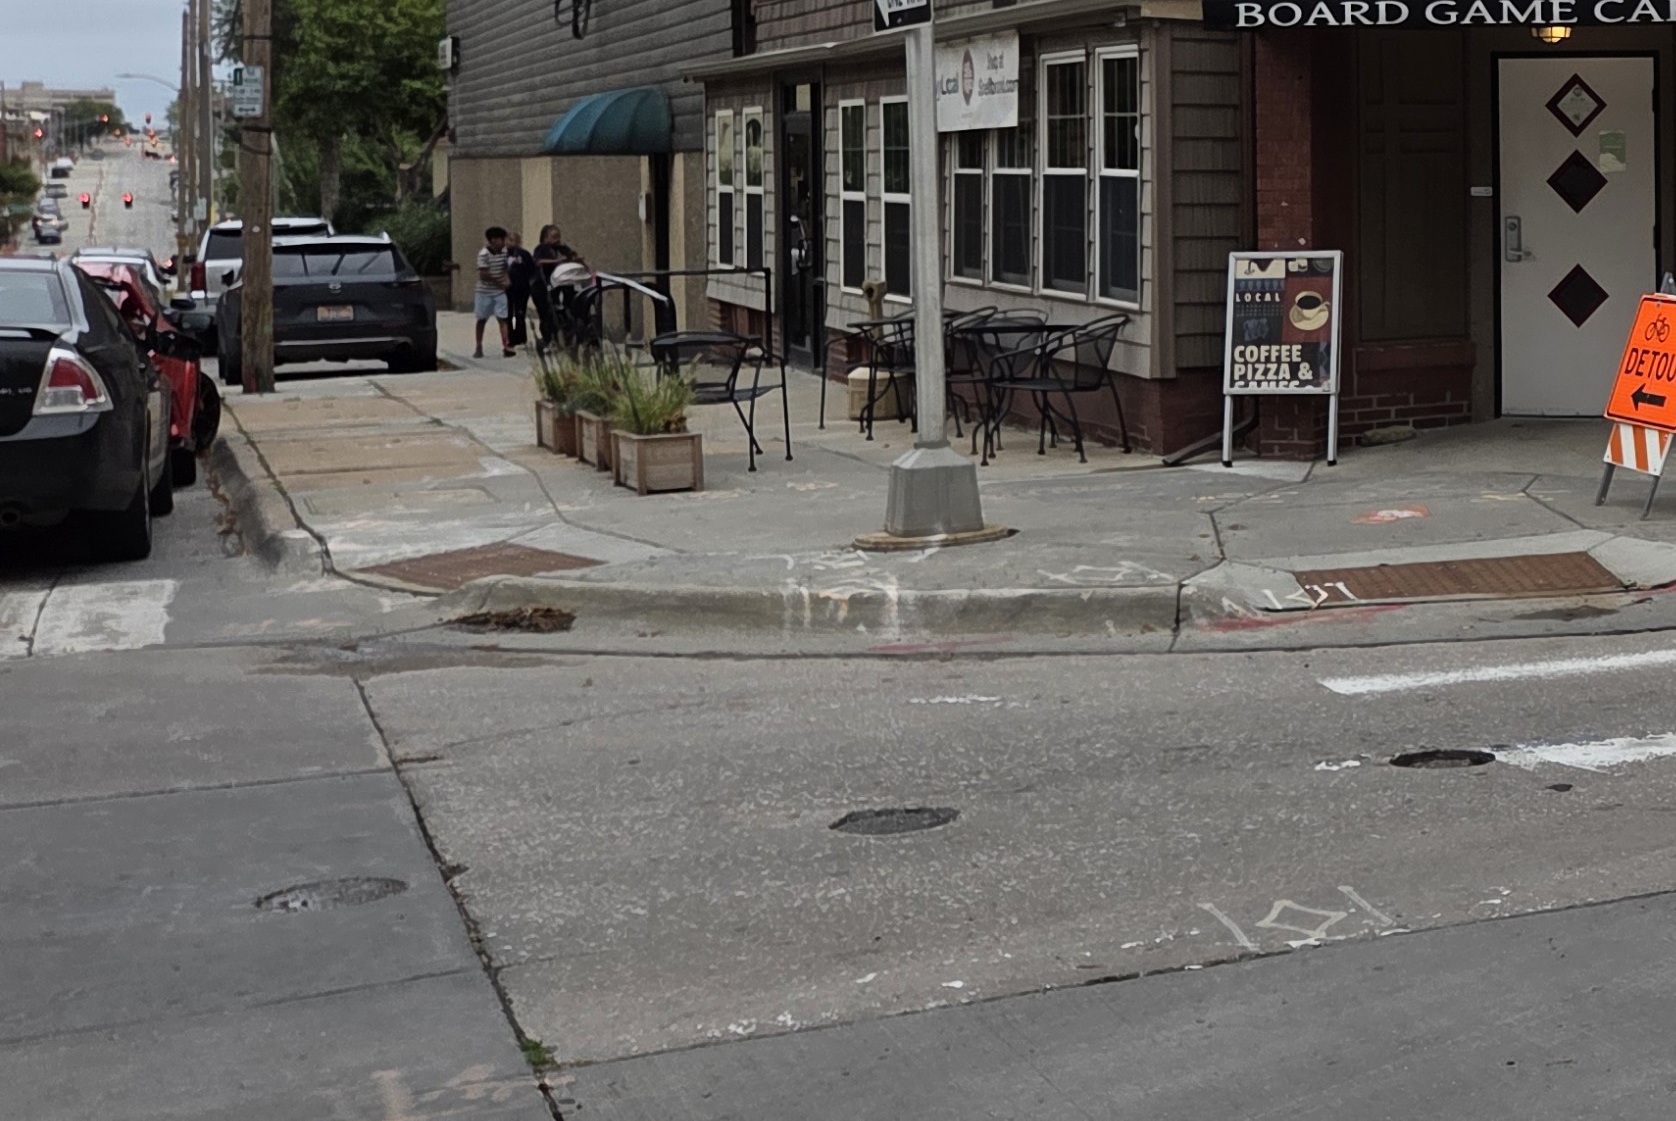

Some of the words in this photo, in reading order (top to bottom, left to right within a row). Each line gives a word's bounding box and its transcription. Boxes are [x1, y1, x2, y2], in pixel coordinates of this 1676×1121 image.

[1234, 1, 1410, 28] BOARD
[1235, 292, 1280, 302] LOCAL
[1233, 345, 1302, 363] COFFEE
[1233, 363, 1291, 380] PIZZA
[1298, 362, 1313, 380] &
